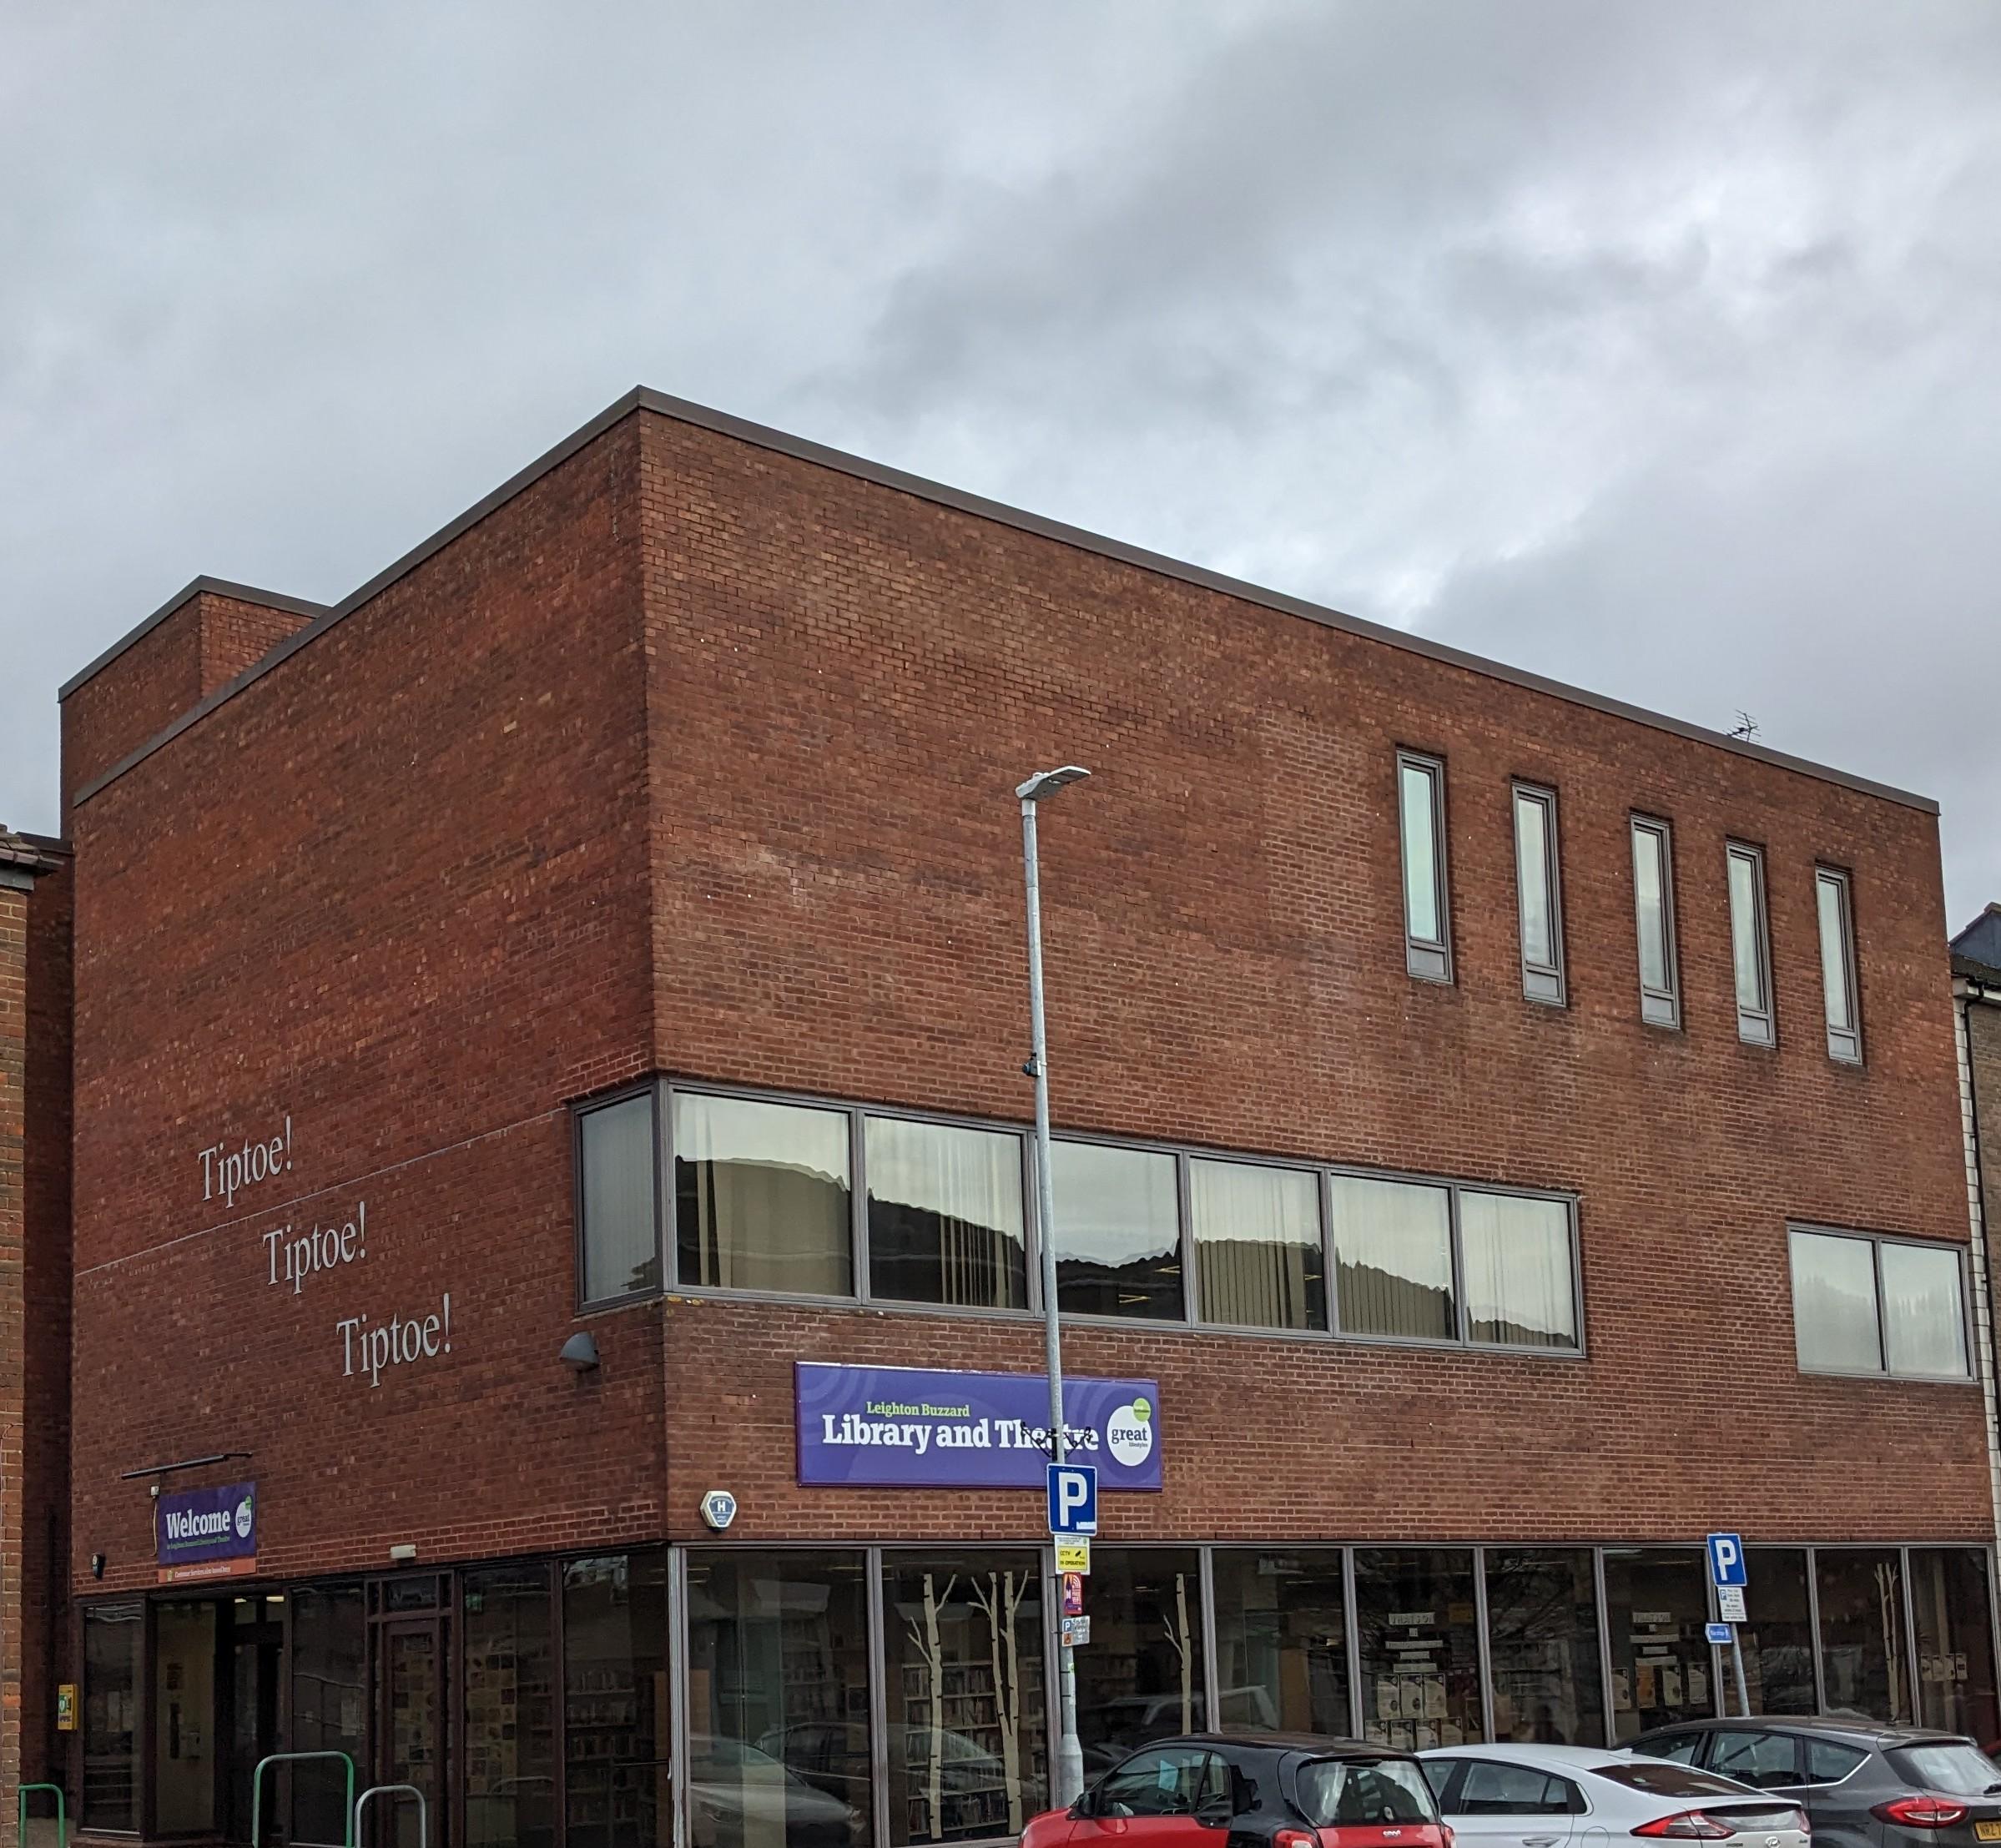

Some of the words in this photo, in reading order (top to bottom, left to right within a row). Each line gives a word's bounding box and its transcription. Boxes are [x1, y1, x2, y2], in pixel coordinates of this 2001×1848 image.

[198, 1115, 291, 1209] Tiptoe!
[263, 1201, 366, 1295] Tiptoe!
[336, 1292, 451, 1388] Tiptoe!
[866, 1401, 920, 1418] Leighton
[921, 1403, 970, 1417] Buzzard
[822, 1413, 932, 1455] Library
[935, 1417, 991, 1448] and
[994, 1419, 1100, 1451] Thetre
[1111, 1427, 1148, 1444] great
[718, 1501, 726, 1512] H
[1058, 1472, 1087, 1527] P
[166, 1508, 231, 1539] Welcome
[1715, 1539, 1736, 1581] P
[1065, 1621, 1071, 1631] P
